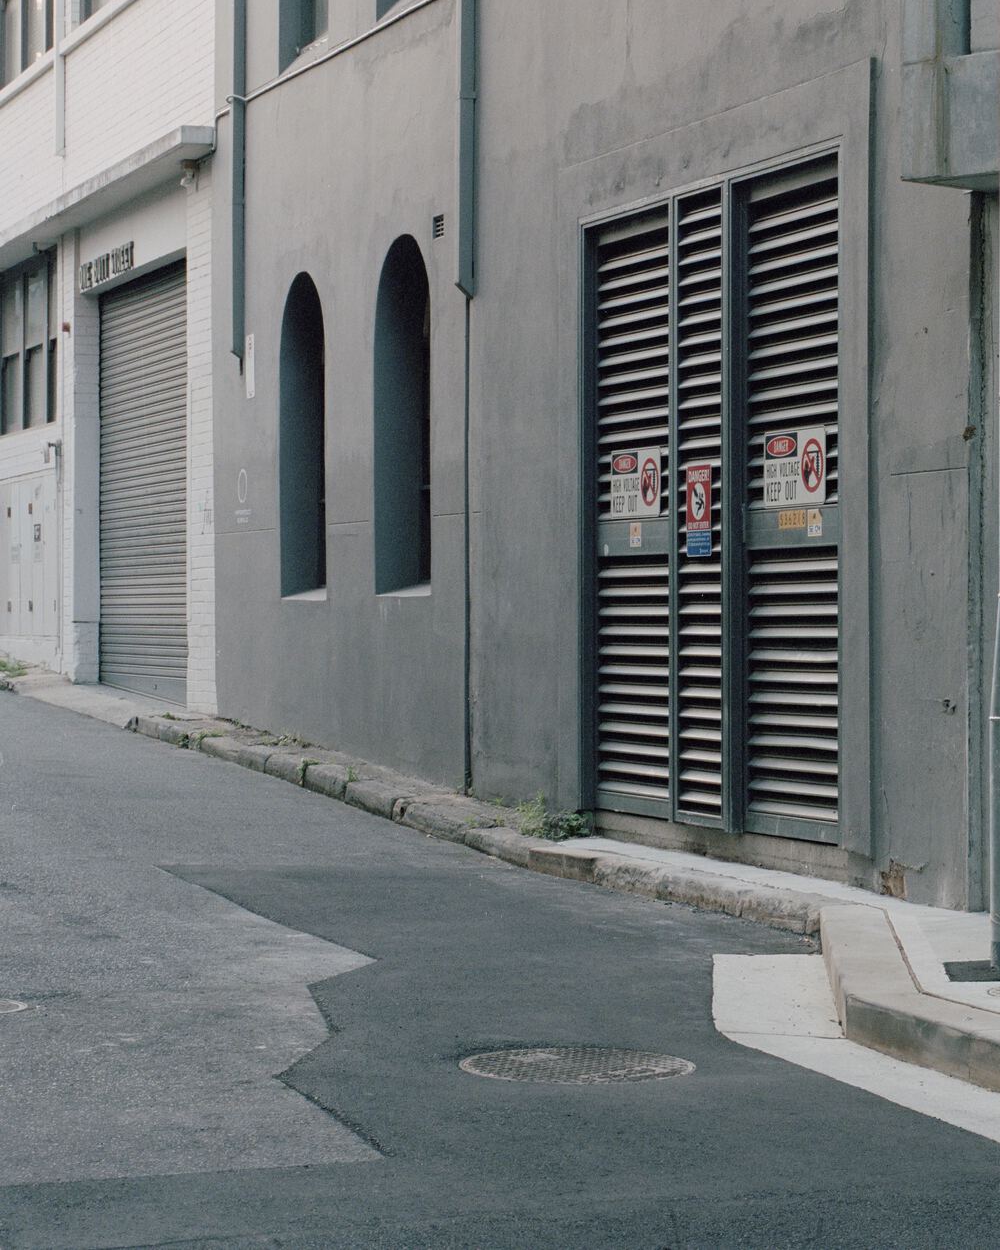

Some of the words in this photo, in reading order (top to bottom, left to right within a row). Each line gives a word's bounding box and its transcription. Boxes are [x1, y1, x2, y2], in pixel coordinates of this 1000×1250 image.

[111, 241, 134, 275] STREET
[773, 440, 789, 453] DANGER
[618, 458, 631, 470] DANGER
[766, 463, 777, 478] HIGH
[779, 461, 800, 478] VOLTAGE
[688, 469, 710, 483] DANGER!
[612, 478, 621, 493] HIGH
[623, 477, 640, 492] VOLTAGE
[766, 481, 782, 502] KEEP
[785, 480, 798, 501] OUT
[613, 496, 626, 513] KEEP
[628, 495, 638, 512] OUT
